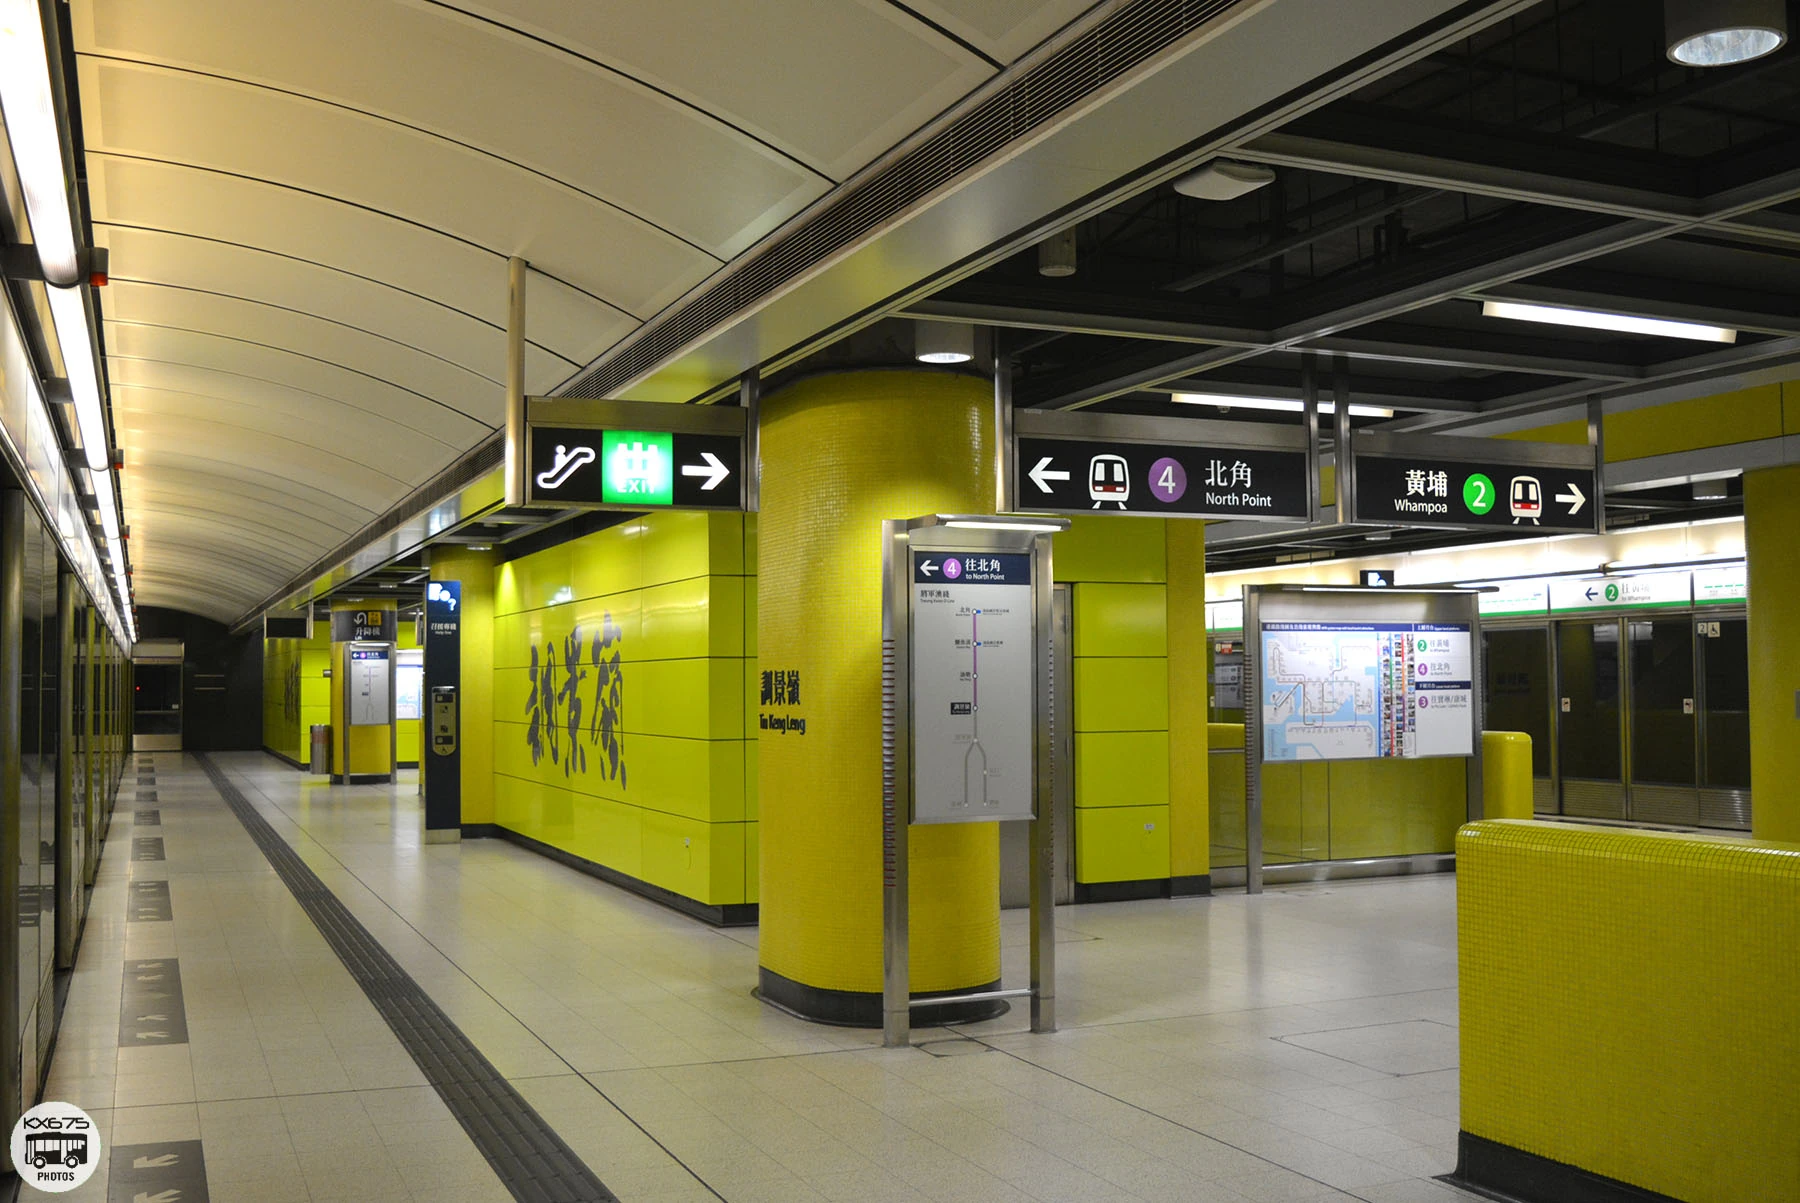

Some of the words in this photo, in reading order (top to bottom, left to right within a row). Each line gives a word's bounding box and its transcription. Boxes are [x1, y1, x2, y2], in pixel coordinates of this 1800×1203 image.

[1157, 465, 1176, 494] 4
[1205, 460, 1252, 488] 北角
[1405, 469, 1448, 497] 黃埔
[1472, 481, 1486, 507] 2
[1206, 492, 1239, 506] North
[1242, 493, 1271, 507] Point
[1394, 499, 1448, 515] Whampoa
[947, 561, 957, 575] 4
[965, 558, 1000, 572] 往北角
[1606, 587, 1615, 601] 2
[769, 714, 785, 735] Keng
[787, 714, 806, 735] Leng
